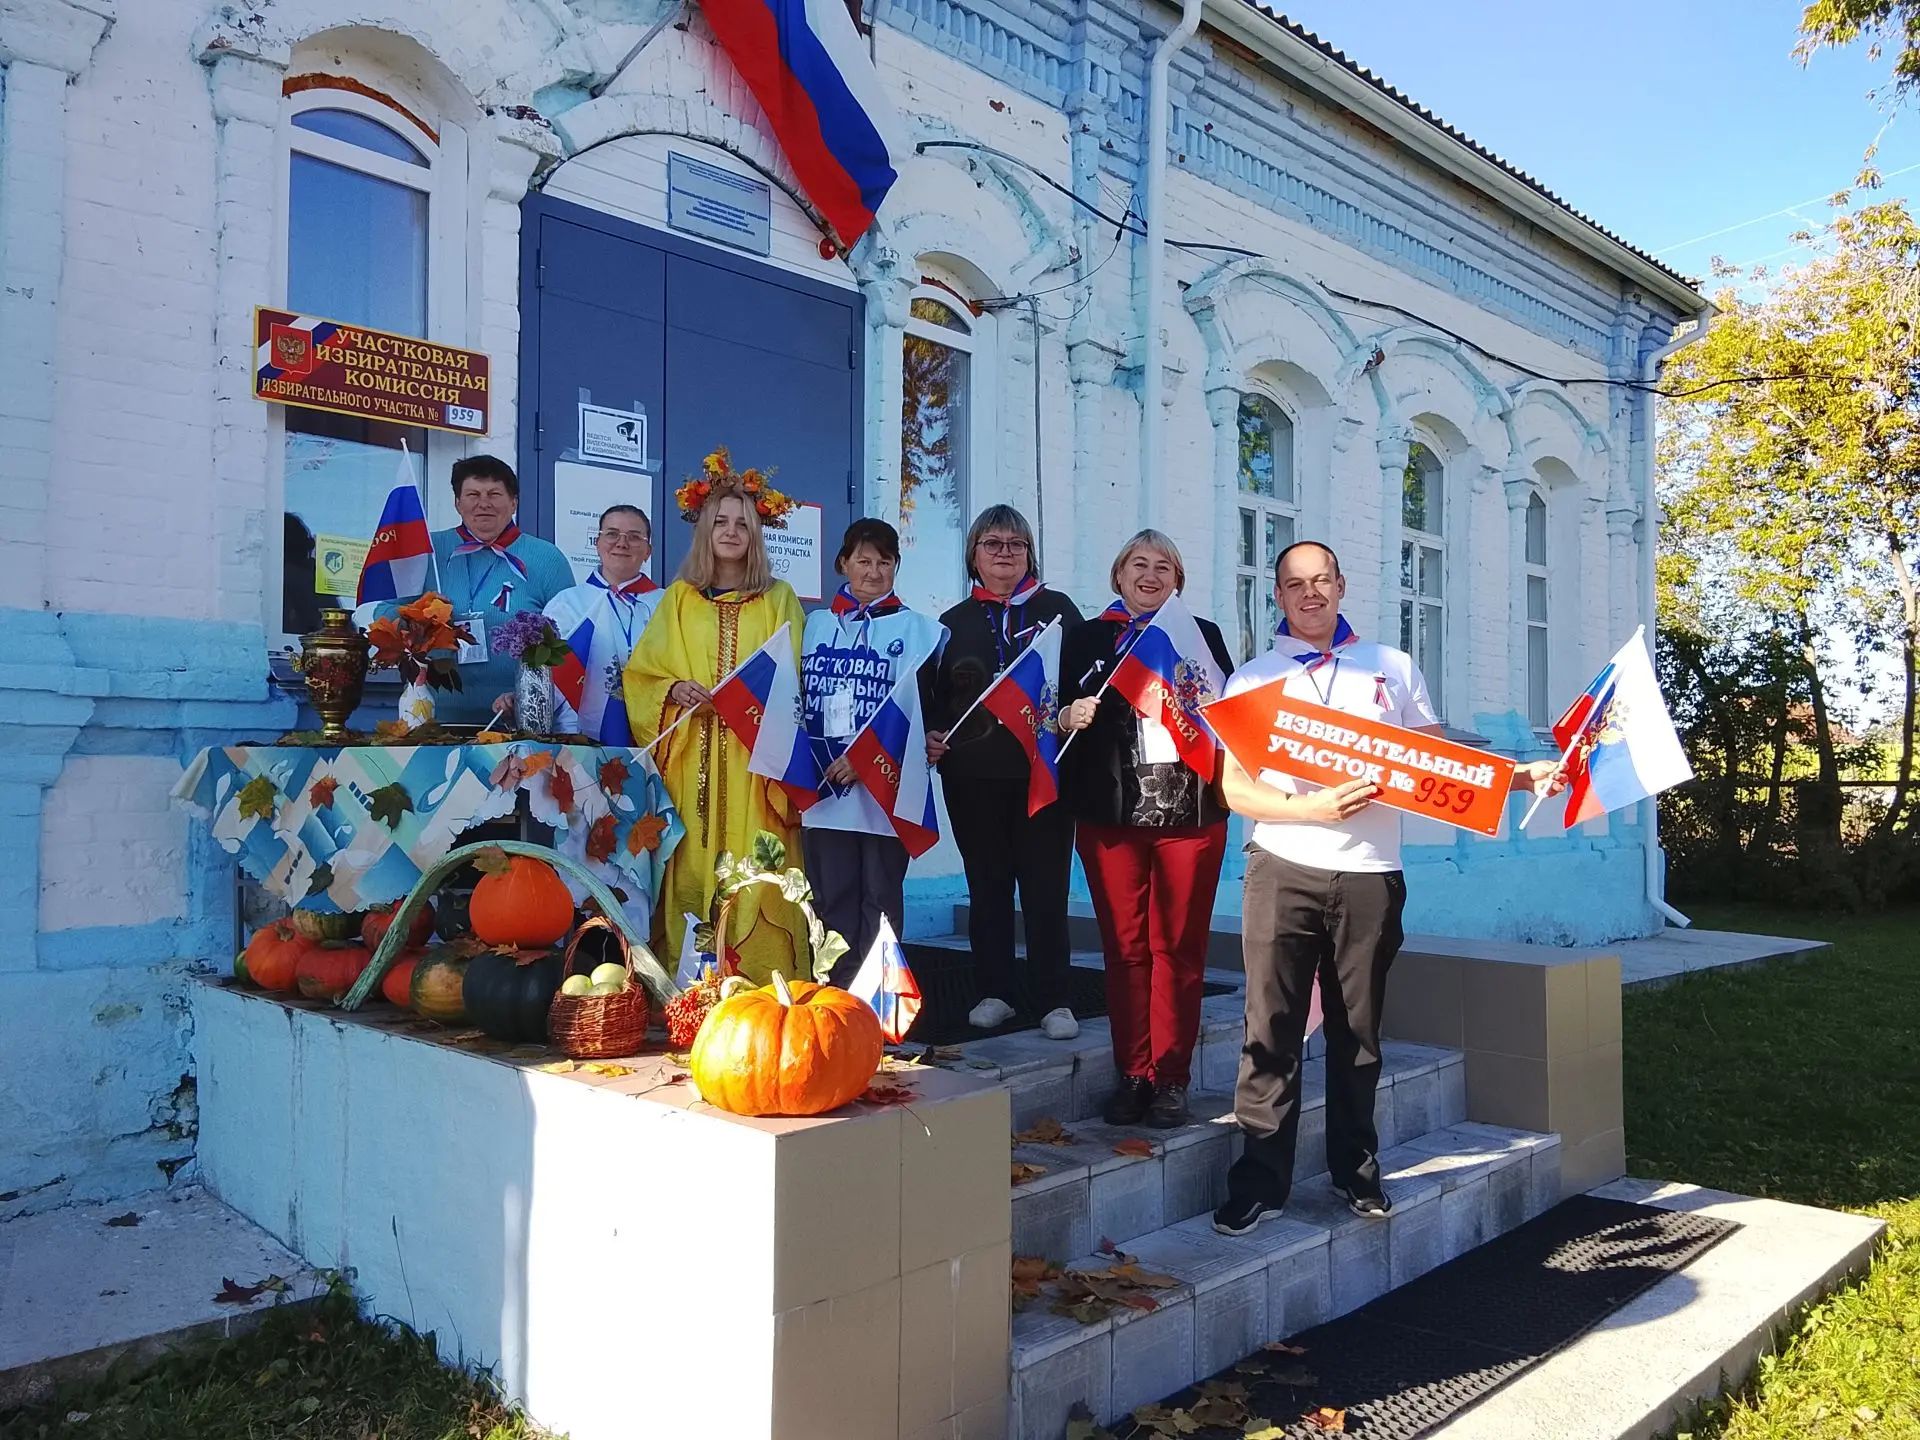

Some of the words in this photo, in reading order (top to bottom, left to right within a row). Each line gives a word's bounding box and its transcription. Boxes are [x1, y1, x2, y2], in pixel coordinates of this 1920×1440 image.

[315, 344, 487, 392] ИЗБИРАТЕЛЬНАЯ
[336, 328, 469, 370] УЧАСТКОВАЯ
[262, 377, 371, 409] ИЗБИРАТЕЛЬНОГО
[373, 397, 425, 419] УЧАСТКА
[451, 407, 474, 422] 959
[344, 369, 461, 405] КОМИССИЯ
[777, 535, 813, 546] КОМИССИЯ
[784, 547, 811, 558] УЧАСТКА
[1145, 681, 1200, 742] РОССИЯ
[1273, 710, 1496, 789] ИЗБИРАТЕЛЬНЫЙ
[1267, 734, 1385, 784] УЧАСТОК
[1414, 776, 1475, 814] 959
